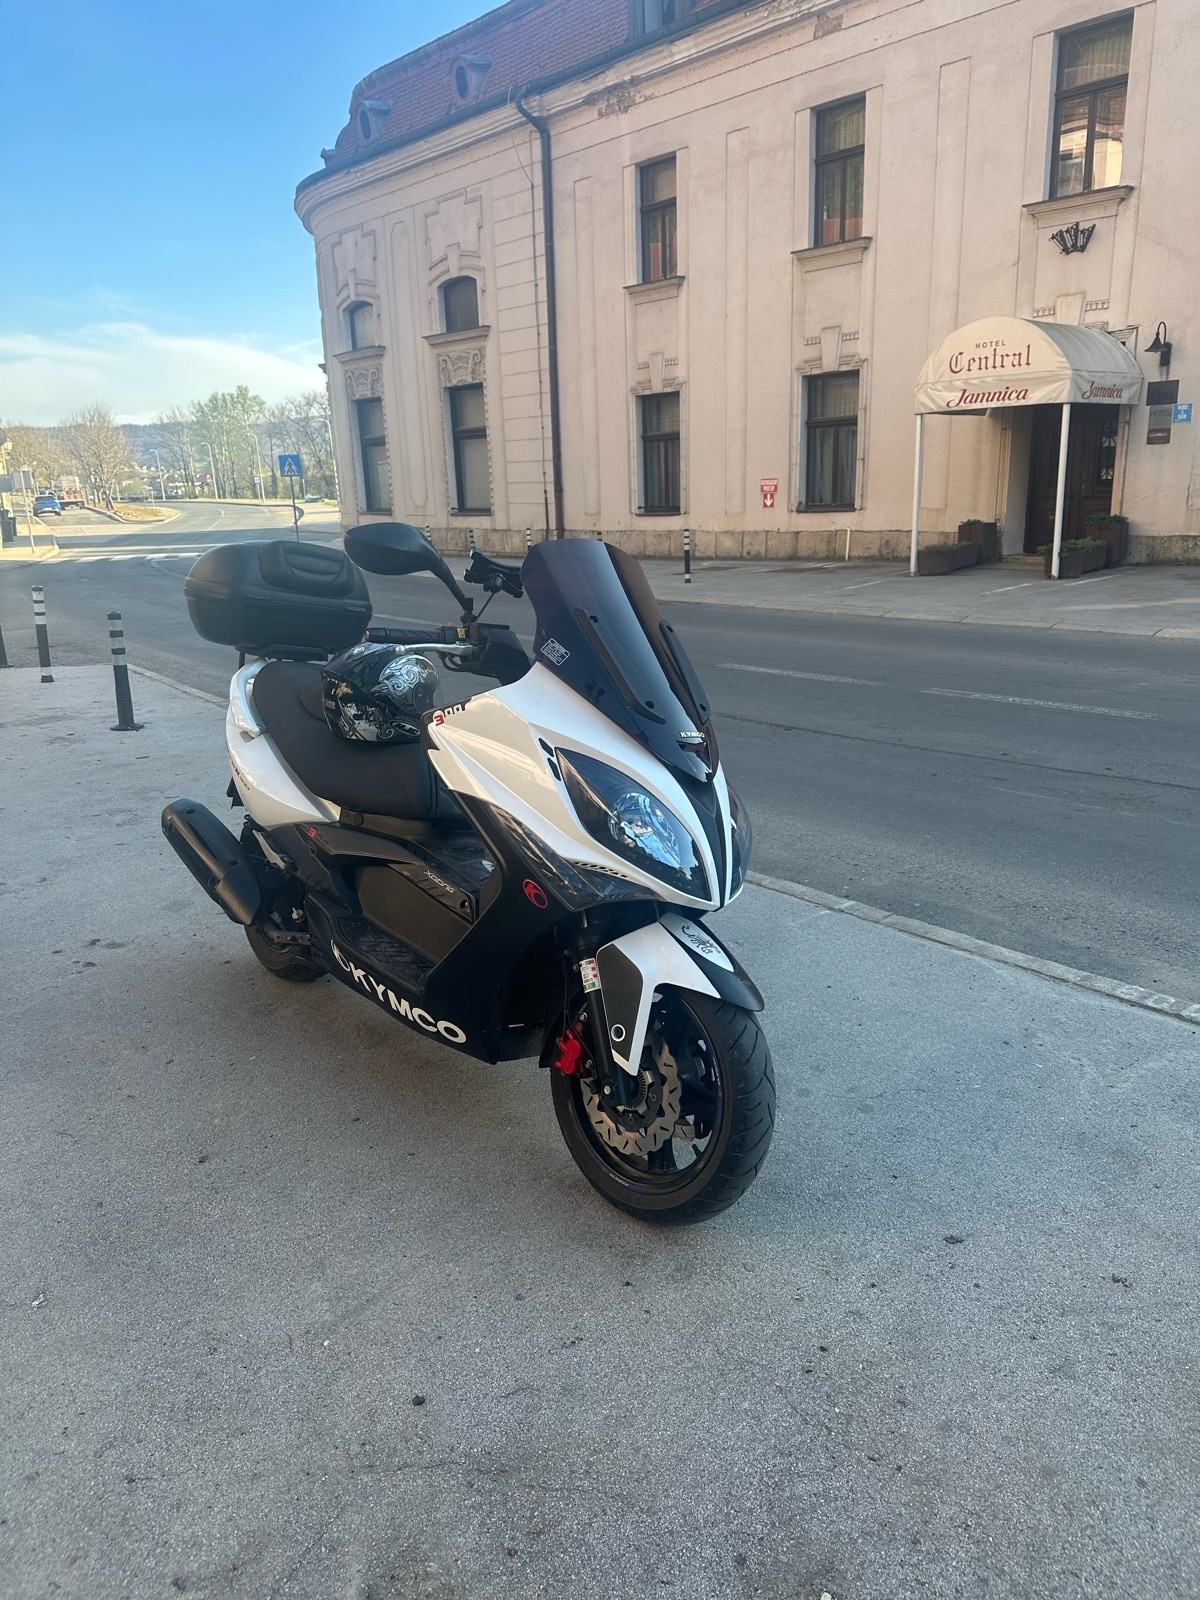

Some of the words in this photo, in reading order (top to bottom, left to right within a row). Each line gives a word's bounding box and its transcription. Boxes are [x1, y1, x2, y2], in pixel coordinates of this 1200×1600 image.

[975, 340, 1006, 349] HOTEL
[949, 344, 1032, 374] Central
[946, 386, 1029, 408] Jamnica
[349, 961, 467, 1043] KYMCO
